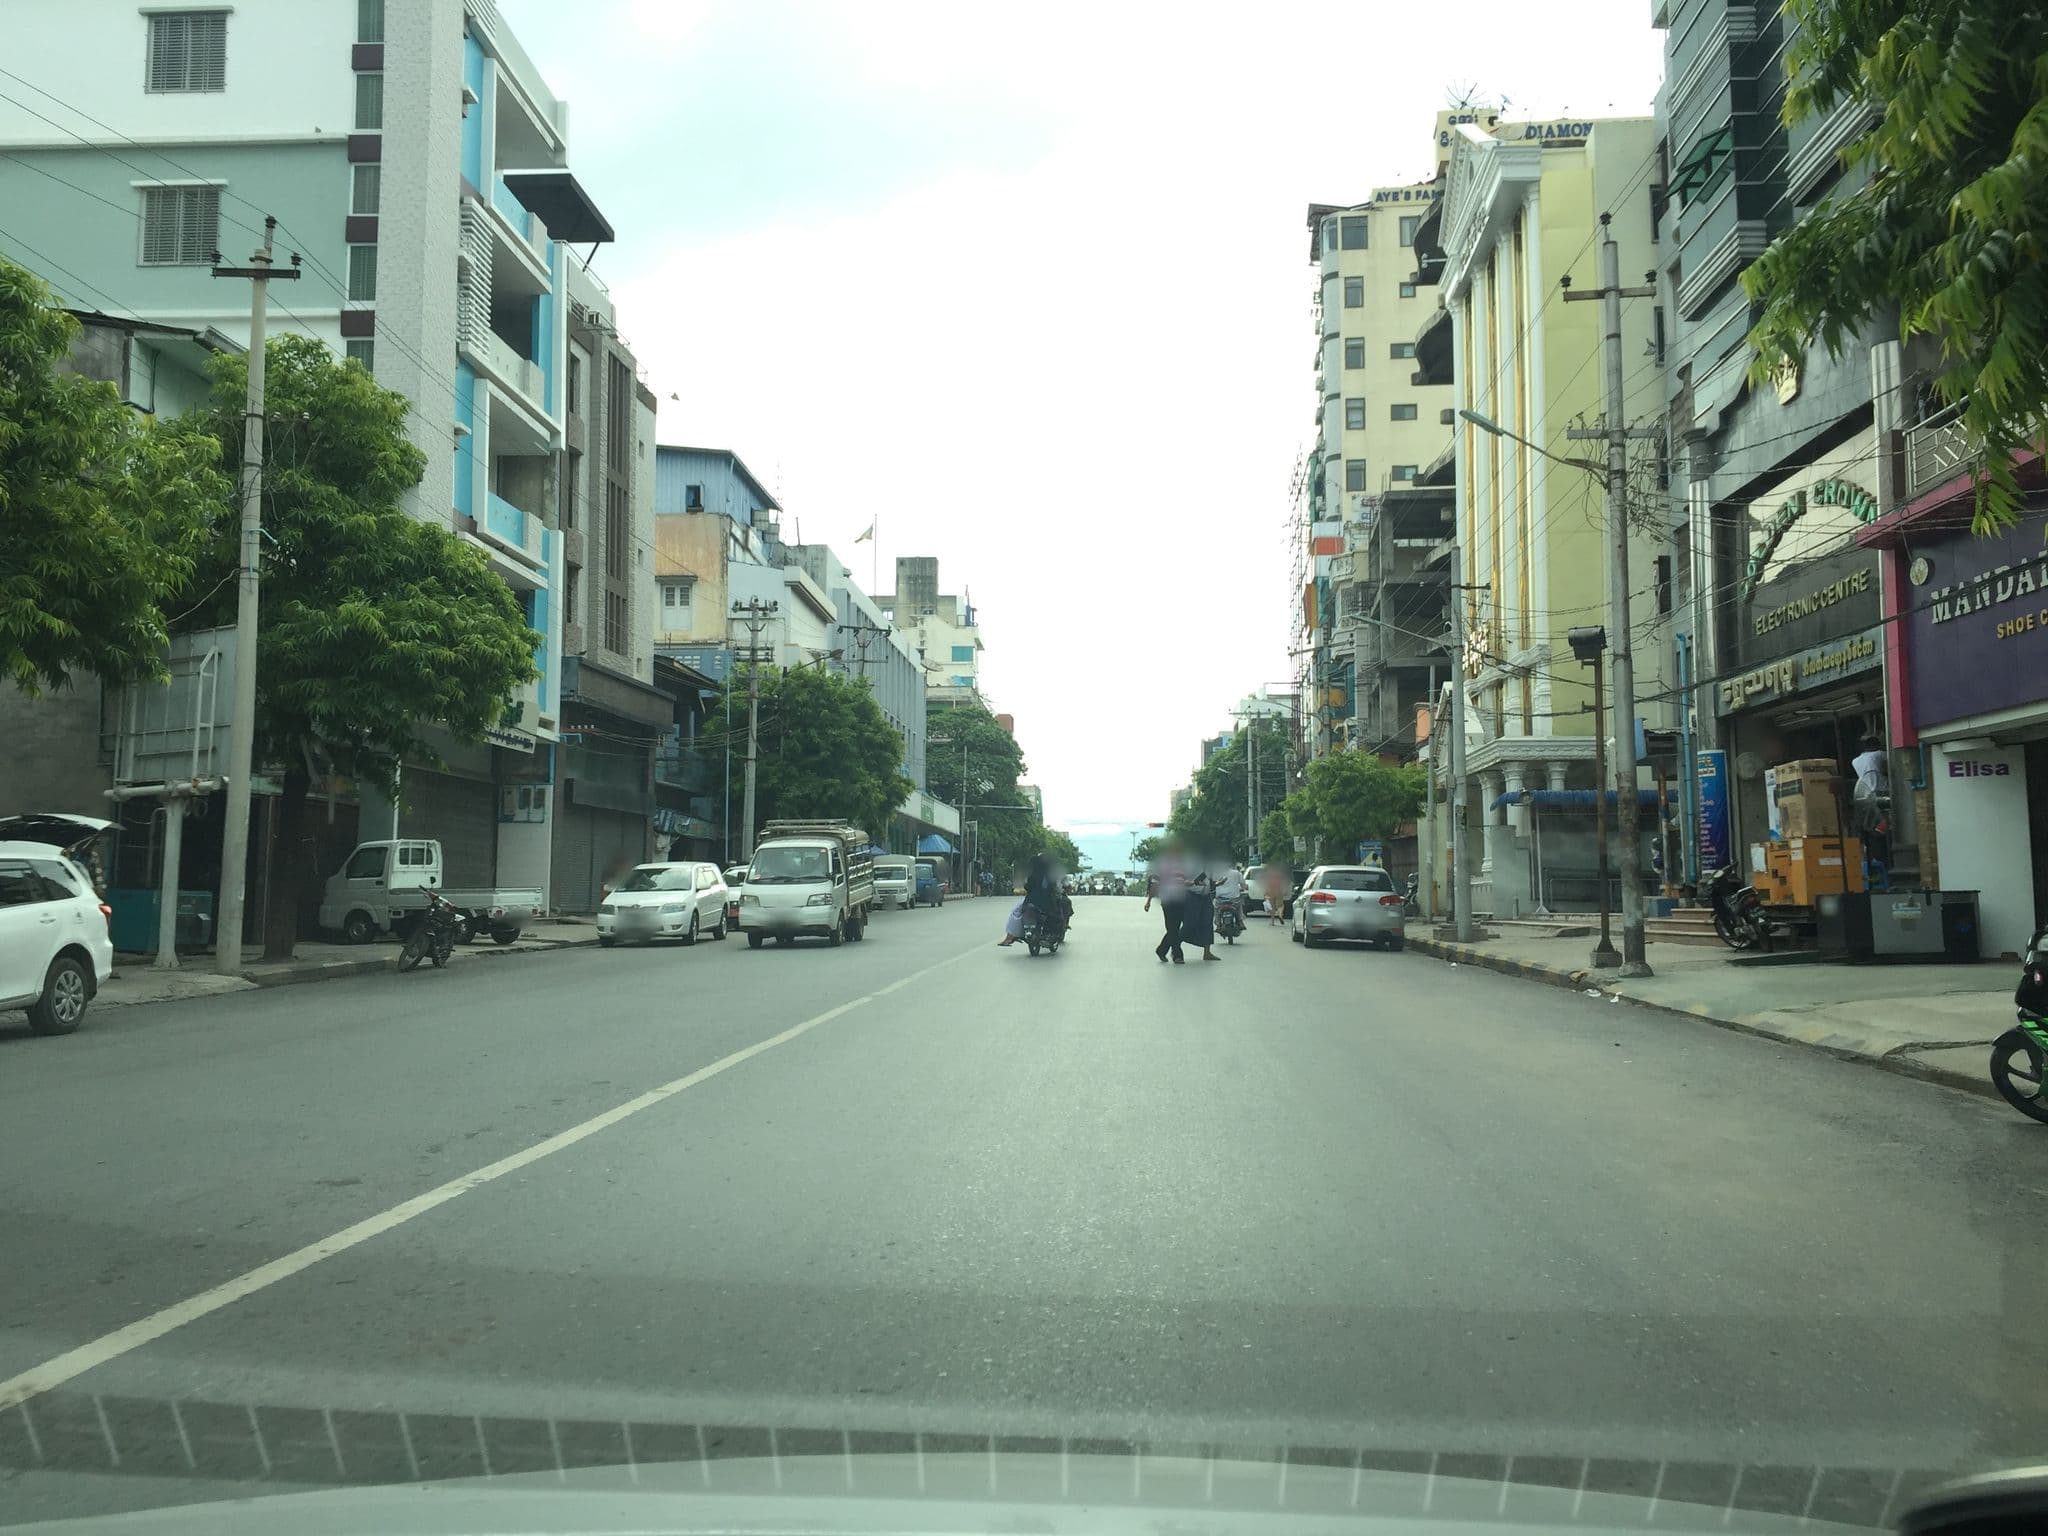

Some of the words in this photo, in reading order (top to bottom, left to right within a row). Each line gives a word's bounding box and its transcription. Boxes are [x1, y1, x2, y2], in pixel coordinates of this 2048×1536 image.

[1755, 591, 1819, 635] ELECTRONIC
[1820, 568, 1871, 608] CENTRE
[1996, 613, 2034, 639] SHOE
[1949, 761, 2010, 777] Elisa
